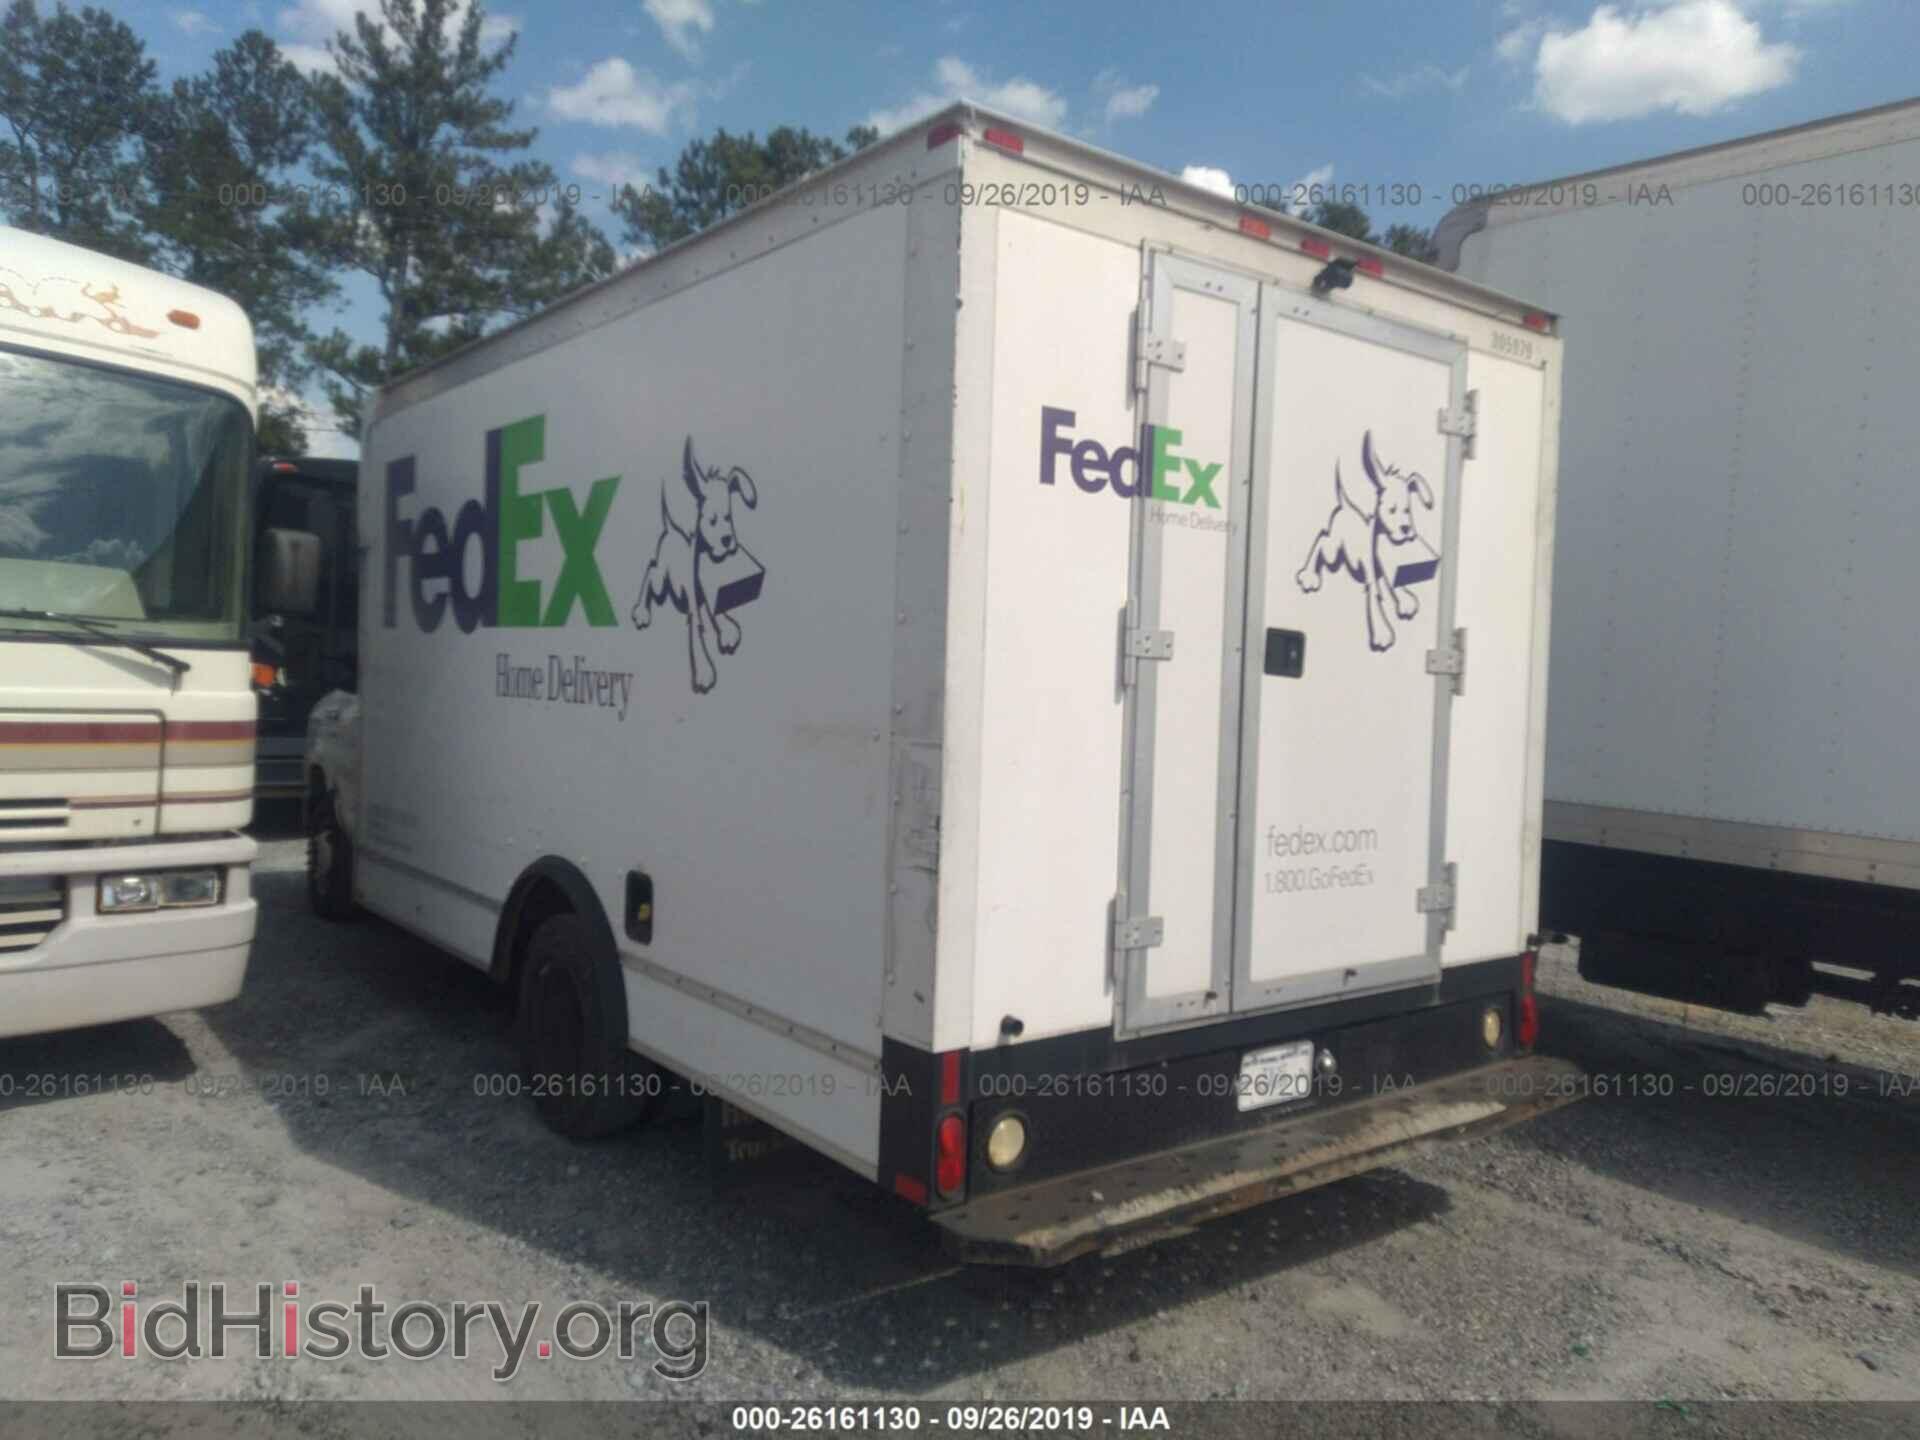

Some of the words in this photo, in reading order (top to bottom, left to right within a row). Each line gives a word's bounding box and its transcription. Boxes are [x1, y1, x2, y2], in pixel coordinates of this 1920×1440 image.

[1038, 404, 1225, 510] FedEx
[382, 412, 623, 635] FedEx
[1150, 507, 1189, 527] Home
[495, 653, 544, 701] Home
[547, 654, 635, 722] Delivery
[1265, 824, 1379, 857] fedex.com
